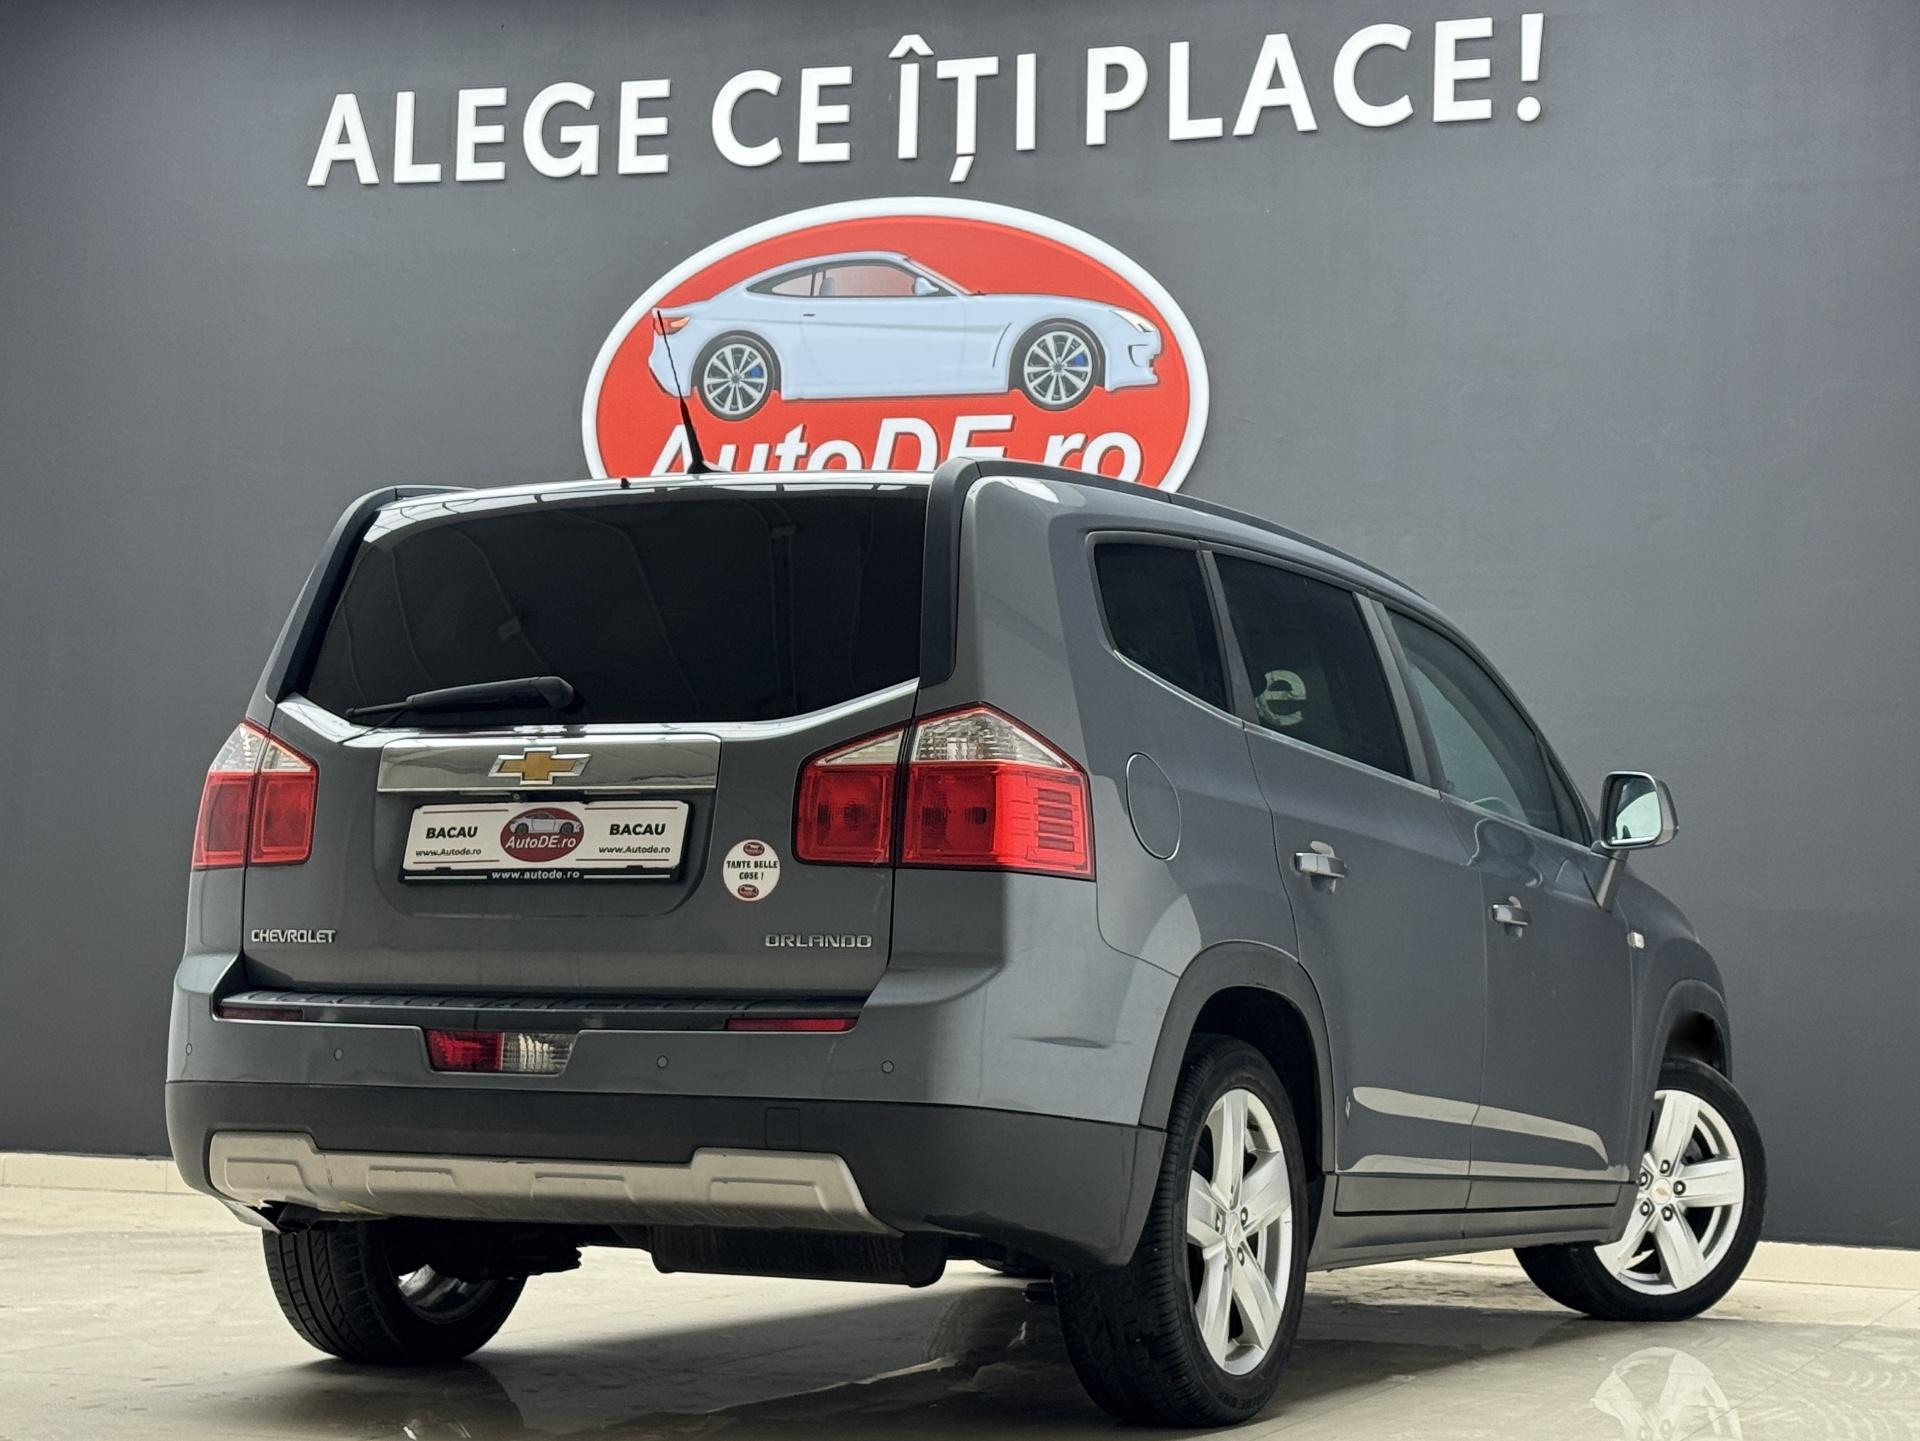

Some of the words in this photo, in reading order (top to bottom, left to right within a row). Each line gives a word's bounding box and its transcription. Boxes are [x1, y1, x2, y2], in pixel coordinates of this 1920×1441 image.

[306, 78, 671, 187] ALEGE
[711, 66, 853, 167] CE
[888, 33, 1037, 183] ÎȚI
[1085, 12, 1544, 146] PLACE!
[425, 825, 479, 840] BACAU
[608, 822, 667, 836] BACAU
[505, 835, 577, 849] AutoDE.ro
[598, 844, 672, 854] www.Autode.ro
[415, 846, 482, 857] www.Autode.ro
[726, 860, 752, 869] TANTE
[753, 860, 778, 869] BELLE
[491, 869, 580, 879] www.autode.ro
[738, 871, 759, 880] COSE
[250, 928, 337, 944] CHEVROLET
[765, 933, 873, 949] ORLANDO
